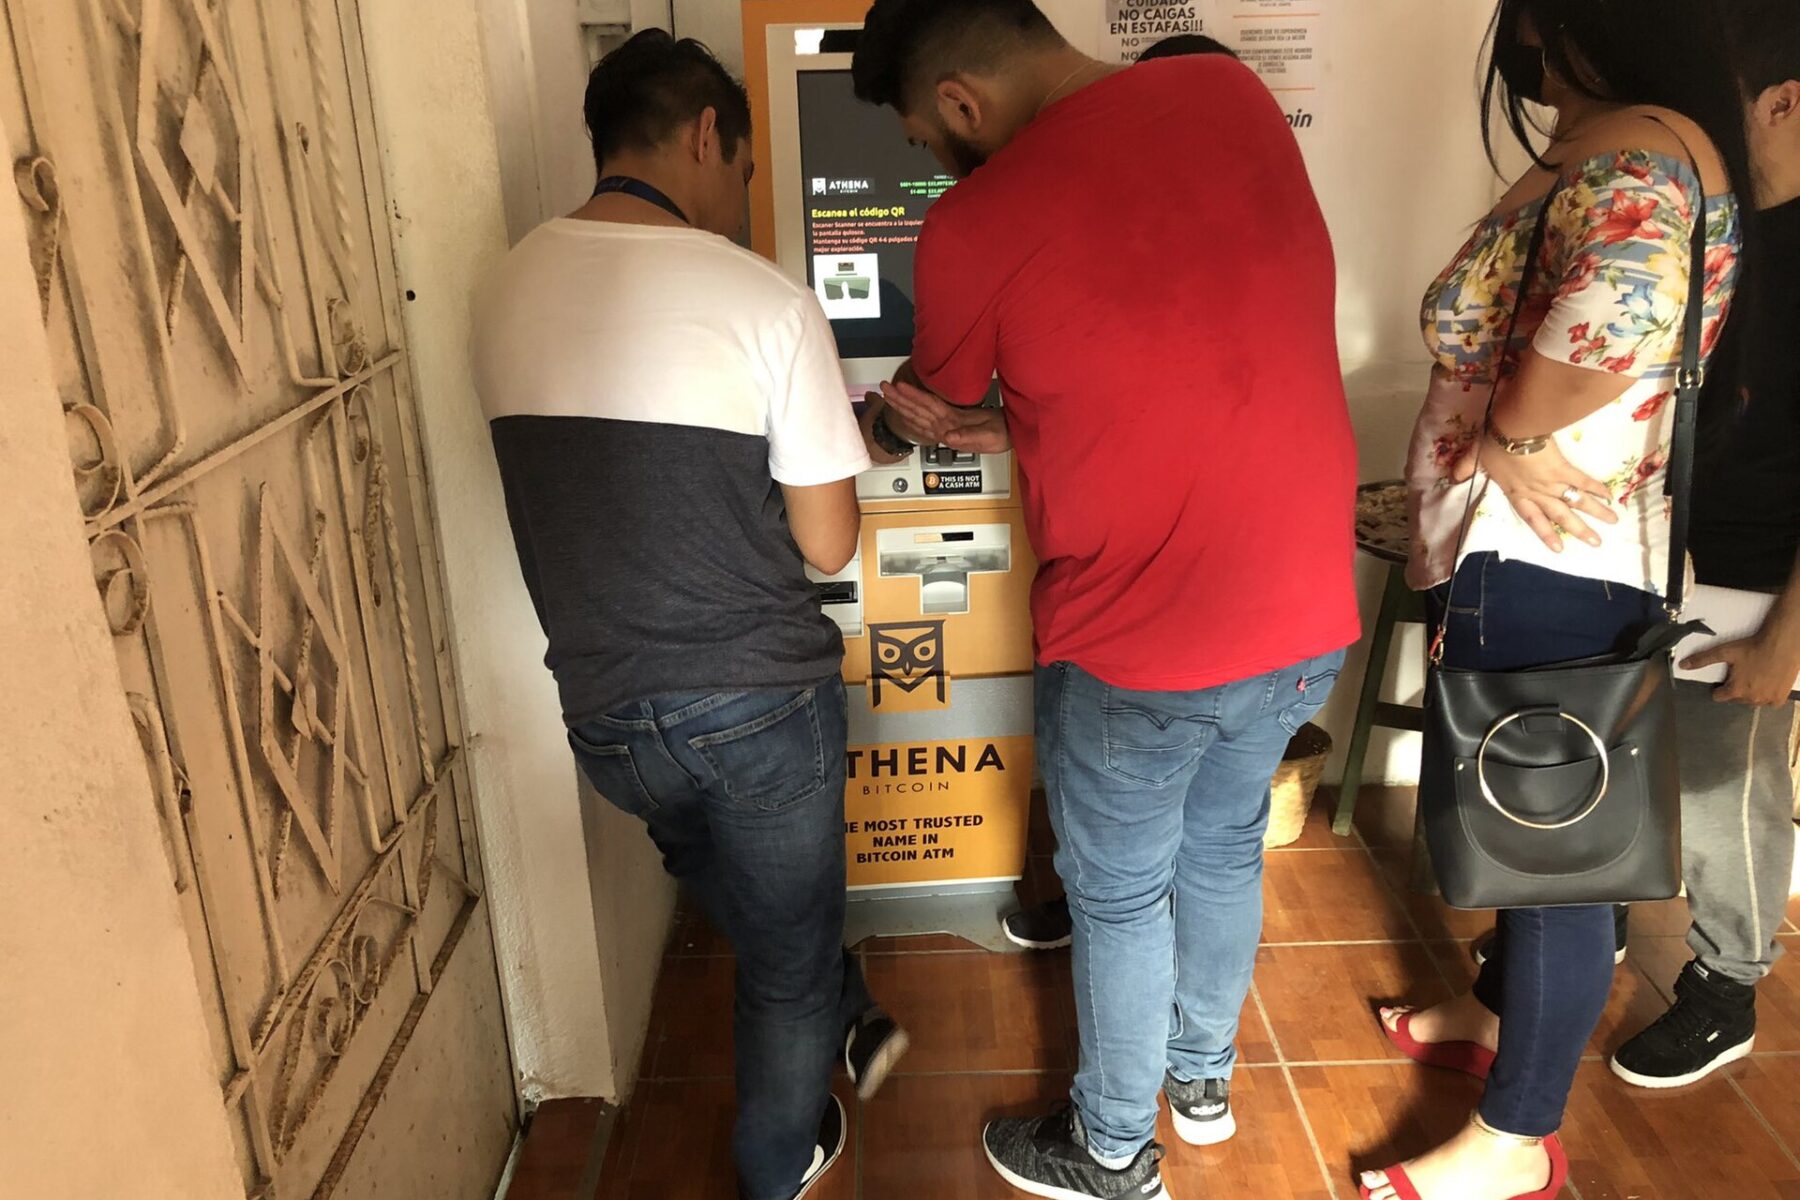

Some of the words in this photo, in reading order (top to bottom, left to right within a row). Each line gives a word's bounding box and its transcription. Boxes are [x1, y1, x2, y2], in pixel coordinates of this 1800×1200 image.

[1119, 9, 1139, 21] NO
[1143, 7, 1195, 20] CAIGAS
[1110, 23, 1127, 34] EN
[1131, 20, 1203, 34] ESTAFAS!!!
[1121, 38, 1139, 47] NO
[1121, 52, 1139, 61] NO
[1285, 108, 1312, 128] oin
[829, 180, 869, 190] ATHENA
[812, 209, 847, 218] Escanea
[849, 208, 858, 217] el
[859, 207, 889, 218] código
[891, 206, 905, 217] QR
[904, 219, 924, 227] izquier
[846, 744, 1005, 779] THENA
[863, 781, 949, 795] BITCOIN
[864, 818, 907, 832] MOST
[913, 815, 983, 829] TRUSTED
[873, 834, 917, 847] NAME
[923, 833, 938, 844] IN
[856, 849, 917, 863] BITCOIN
[923, 848, 954, 859] ATM
